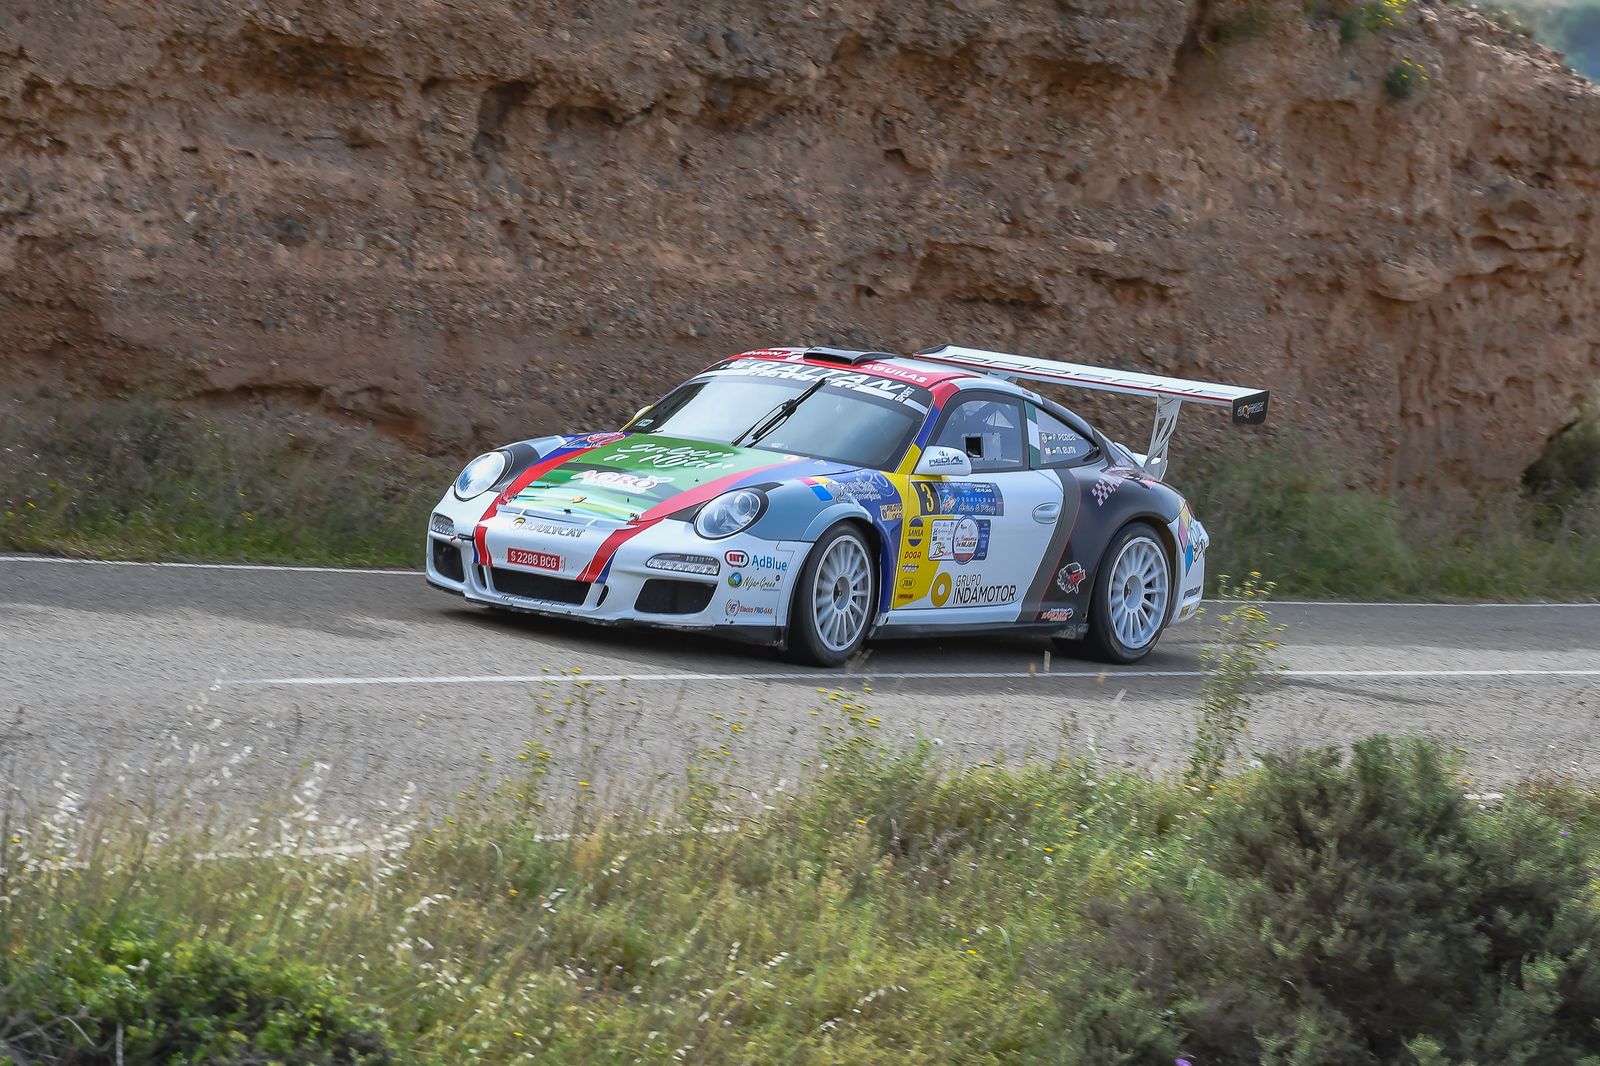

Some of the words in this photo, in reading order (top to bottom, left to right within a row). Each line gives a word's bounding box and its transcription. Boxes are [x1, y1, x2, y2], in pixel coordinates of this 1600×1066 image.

[860, 363, 928, 383] AGUILAS
[920, 482, 934, 513] 3
[907, 528, 924, 537] SANSA
[510, 550, 516, 562] S
[539, 555, 557, 569] BCG
[751, 554, 788, 572] AdBlue
[904, 551, 922, 559] DOGA
[955, 573, 982, 588] GRUPO
[952, 583, 1018, 605] INDAMOTOR
